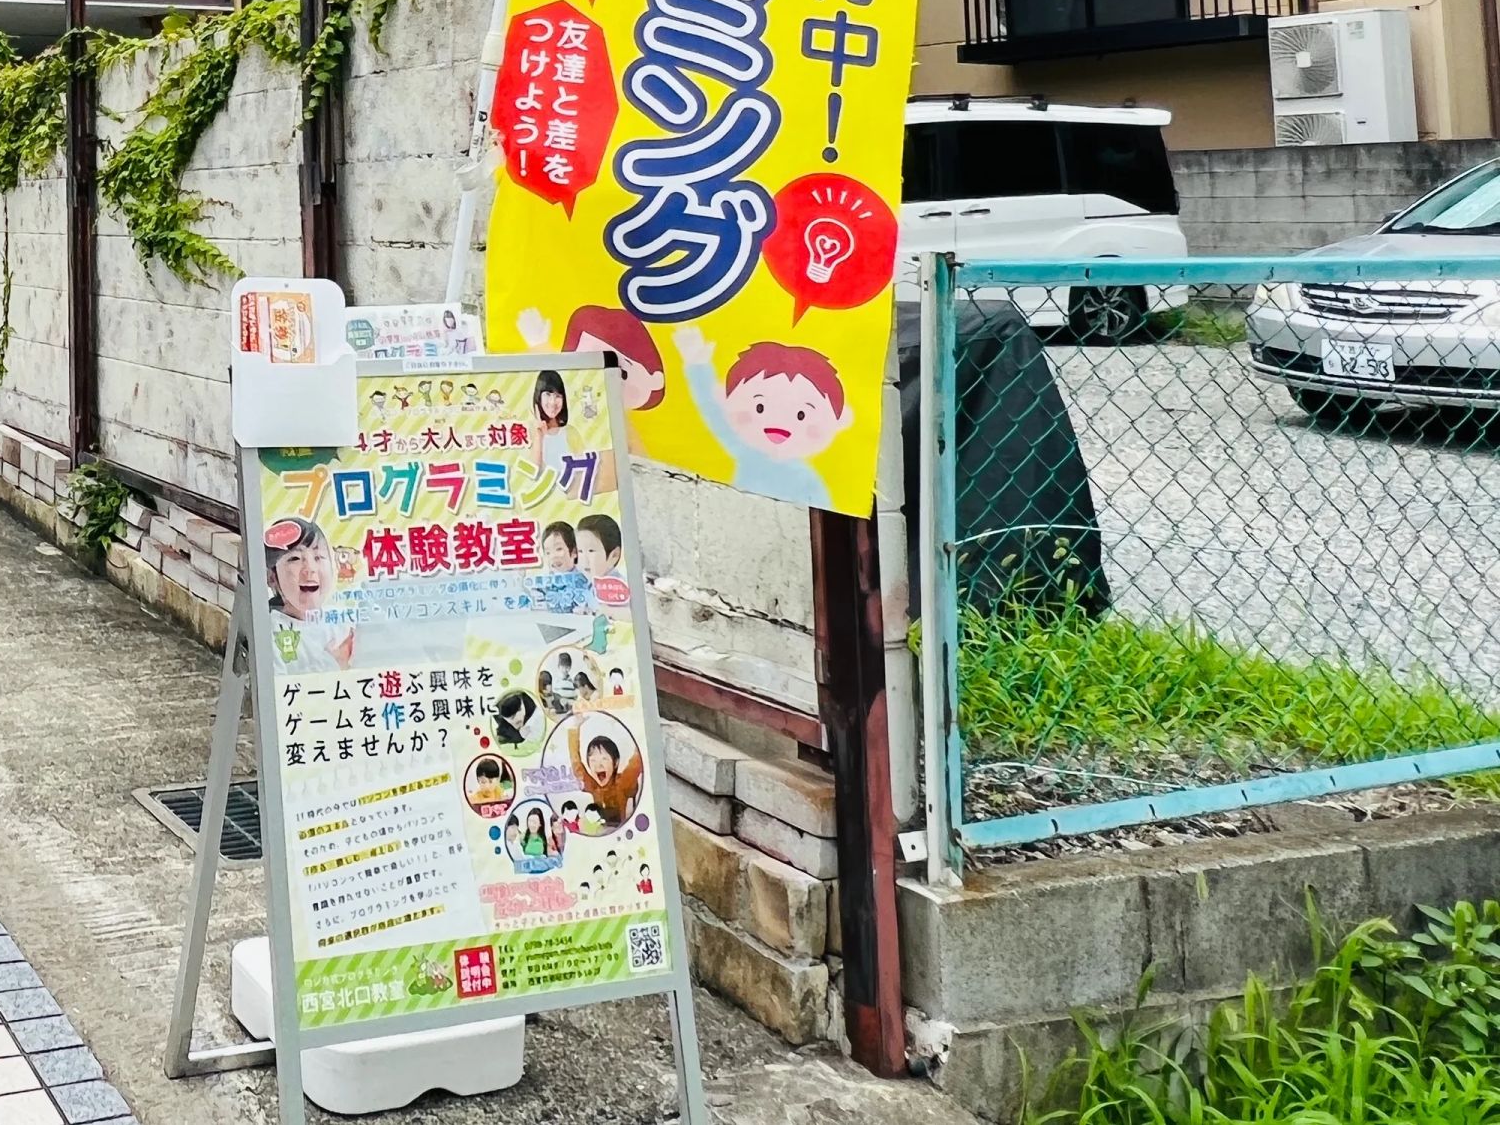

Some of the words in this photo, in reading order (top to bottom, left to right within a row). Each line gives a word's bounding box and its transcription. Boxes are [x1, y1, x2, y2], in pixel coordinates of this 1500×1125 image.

[542, 18, 590, 185] 友達と差を
[356, 422, 530, 453] 4才から大人まで対象
[281, 452, 598, 521] プログラミング
[363, 519, 540, 578] 体験教室
[283, 667, 494, 702] ゲームで遊ぶ興味を
[285, 696, 499, 731] ゲームを作る興味に
[286, 728, 449, 766] 変えませんか？
[301, 978, 406, 1014] 西宮北口教室
